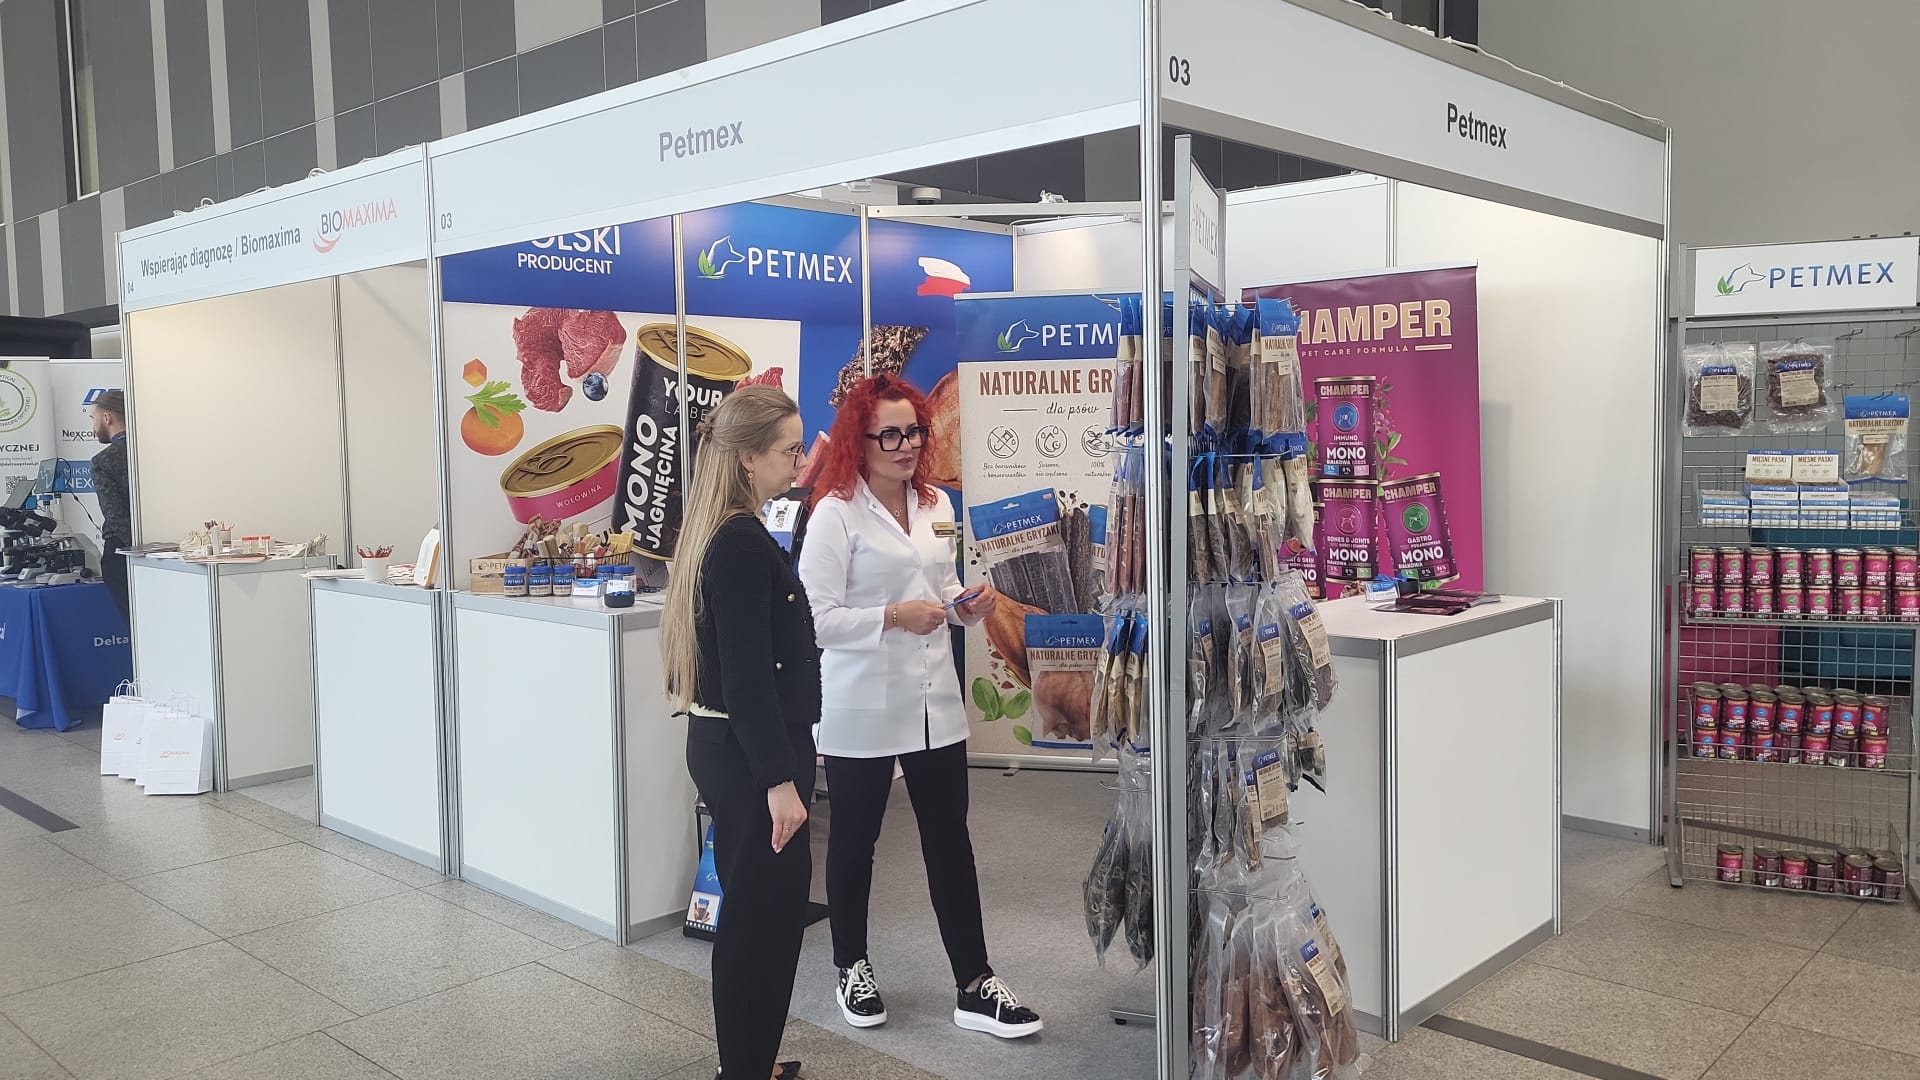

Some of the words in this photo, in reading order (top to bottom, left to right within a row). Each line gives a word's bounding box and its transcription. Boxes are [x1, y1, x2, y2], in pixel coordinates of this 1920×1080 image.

[1169, 55, 1191, 86] 03
[1447, 102, 1507, 150] Petmex
[659, 120, 744, 162] Petmex
[321, 199, 398, 235] BIOMAXIMA
[440, 213, 453, 230] 03
[141, 252, 188, 279] Wspierając
[191, 243, 233, 269] diagnozę
[235, 237, 239, 257] /
[241, 226, 301, 256] Biomaxima
[518, 252, 613, 275] PRODUCENT
[747, 247, 853, 285] PETMEX
[1769, 261, 1894, 288] PETMEX
[1298, 300, 1452, 345] HAMPER
[1042, 323, 1121, 347] PETM
[1357, 345, 1408, 354] FORMULA
[663, 376, 723, 407] YOUR
[979, 369, 1082, 396] NATURALNE
[1088, 368, 1116, 393] GR
[1320, 384, 1369, 396] CHAMPER
[664, 402, 711, 421] LABE
[1046, 402, 1065, 415] dla
[1068, 403, 1099, 421] psów
[1326, 446, 1366, 460] MONO
[621, 414, 658, 541] MONO
[646, 426, 678, 549] JAGNIĘCINA
[555, 484, 601, 508] WOŁOWINA
[1323, 487, 1372, 499] CHAMPER
[1384, 482, 1437, 500] CHAMPER
[1006, 514, 1042, 530] PETMEX
[981, 533, 1025, 553] NATURALNE
[1027, 524, 1060, 541] GRYZAKI
[1407, 534, 1432, 544] GASTRO
[1329, 548, 1369, 562] MONO
[1401, 546, 1444, 563] MONO
[94, 635, 129, 647] Delta
[1060, 636, 1097, 645] PETMEX
[1030, 650, 1076, 660] NATURALNE
[1077, 650, 1099, 660] GRYZ
